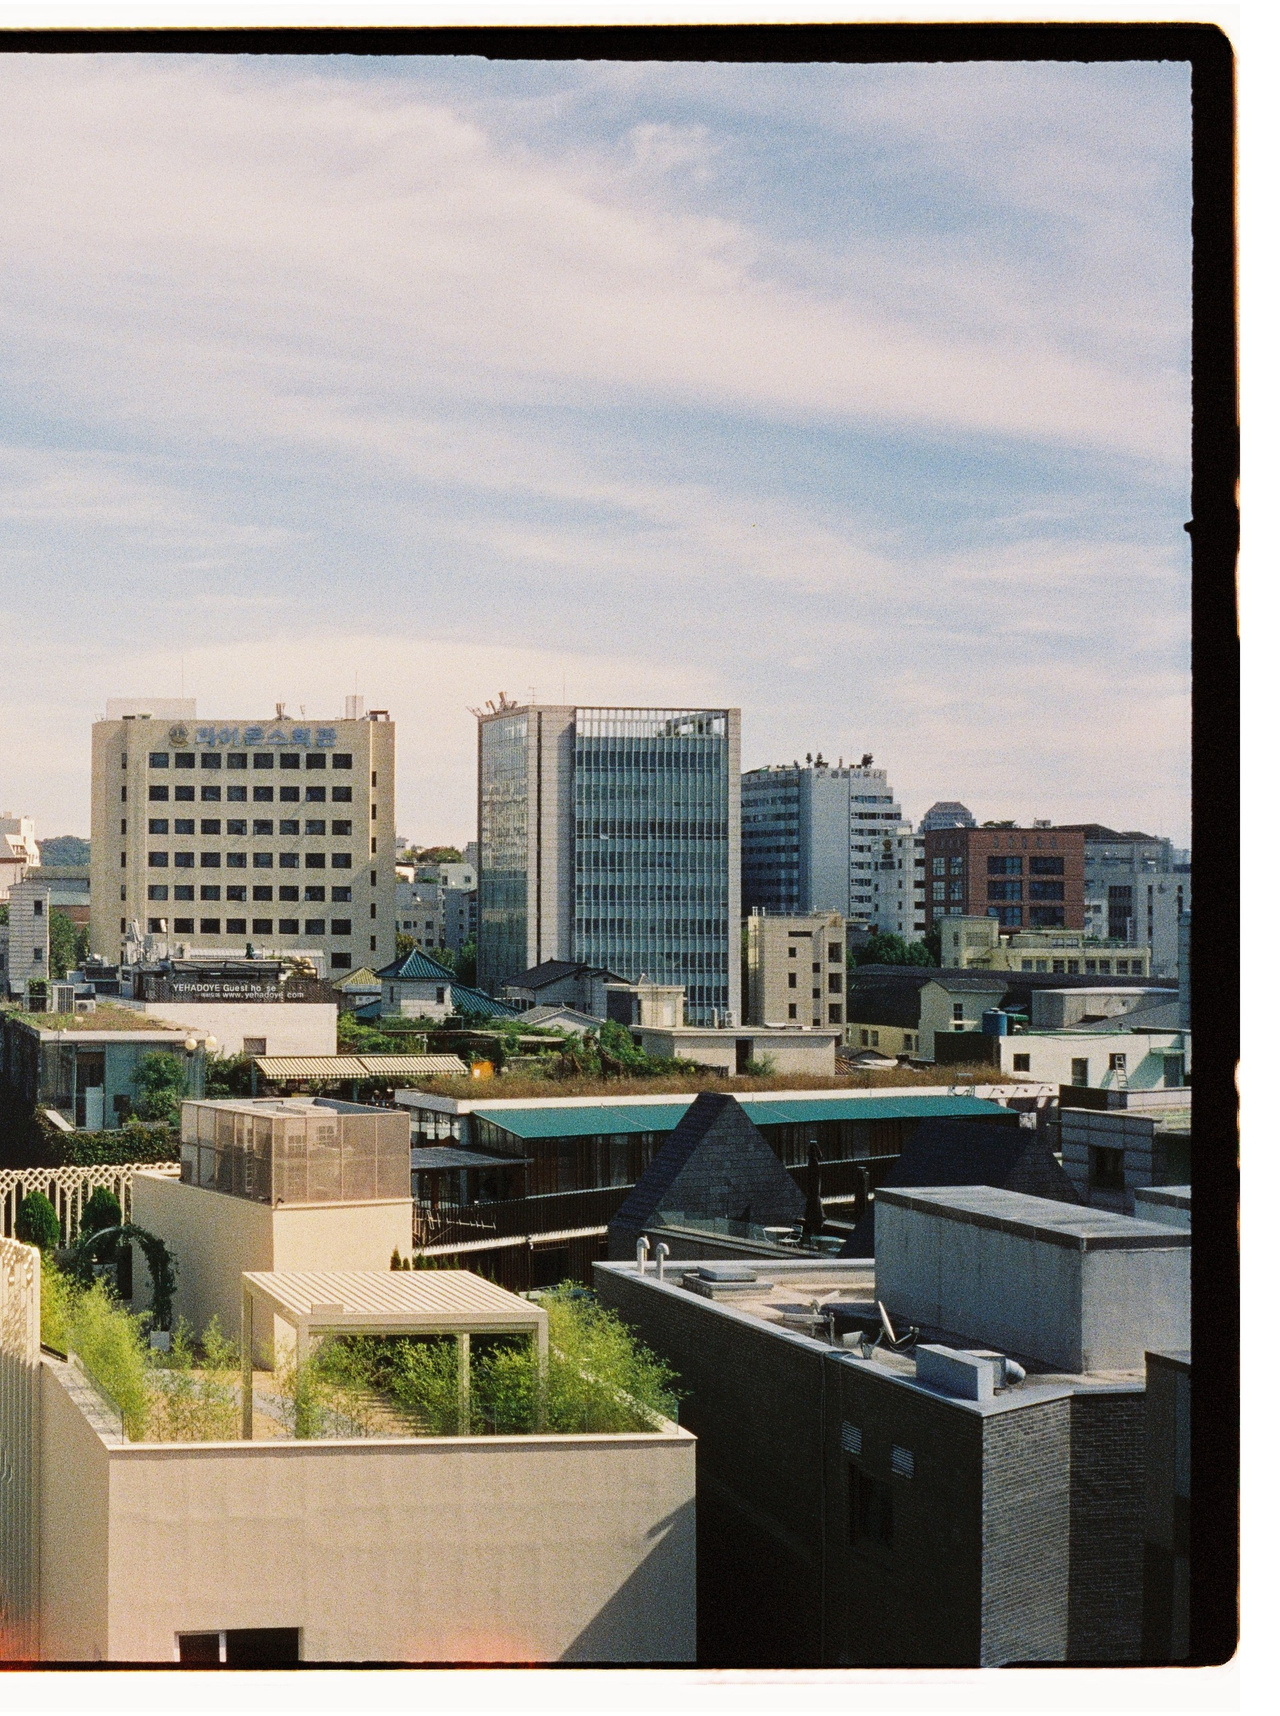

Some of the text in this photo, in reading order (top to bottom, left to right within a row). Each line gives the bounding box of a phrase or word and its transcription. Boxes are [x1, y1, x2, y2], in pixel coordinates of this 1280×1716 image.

[173, 983, 276, 992] YEHADOYE Guest hose
